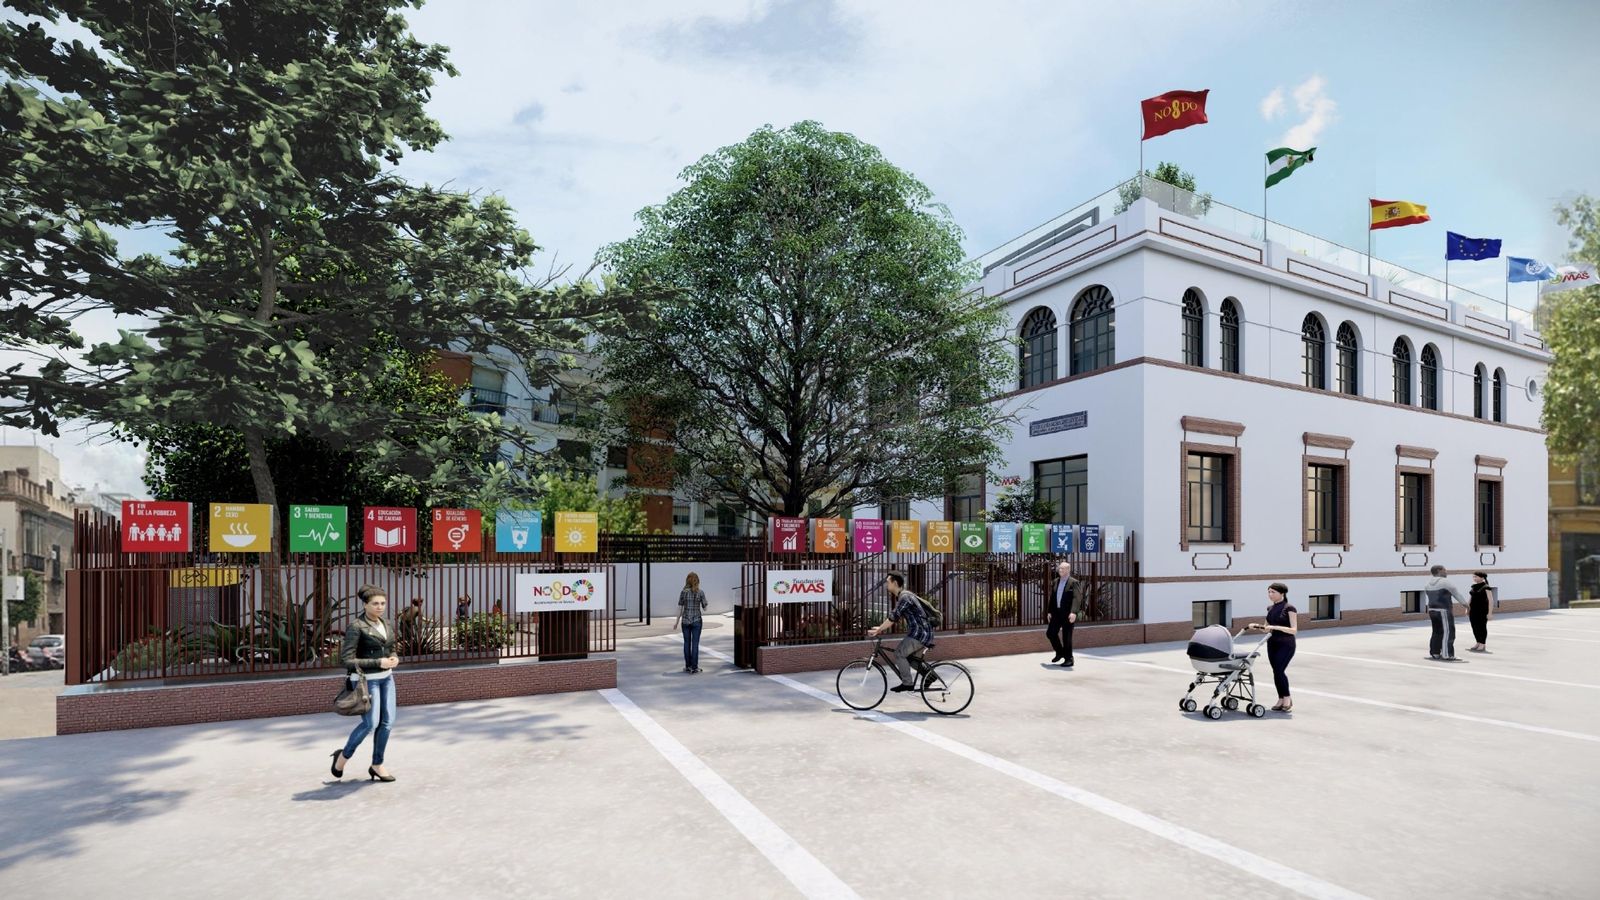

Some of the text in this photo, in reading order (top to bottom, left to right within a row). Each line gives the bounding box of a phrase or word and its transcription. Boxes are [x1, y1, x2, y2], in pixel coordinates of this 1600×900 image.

[1562, 271, 1590, 283] MAS
[128, 503, 135, 515] 1
[214, 505, 221, 518] 2
[294, 506, 301, 519] 3
[367, 509, 375, 520] 4
[435, 510, 442, 521] 5
[789, 583, 825, 594] MAS
